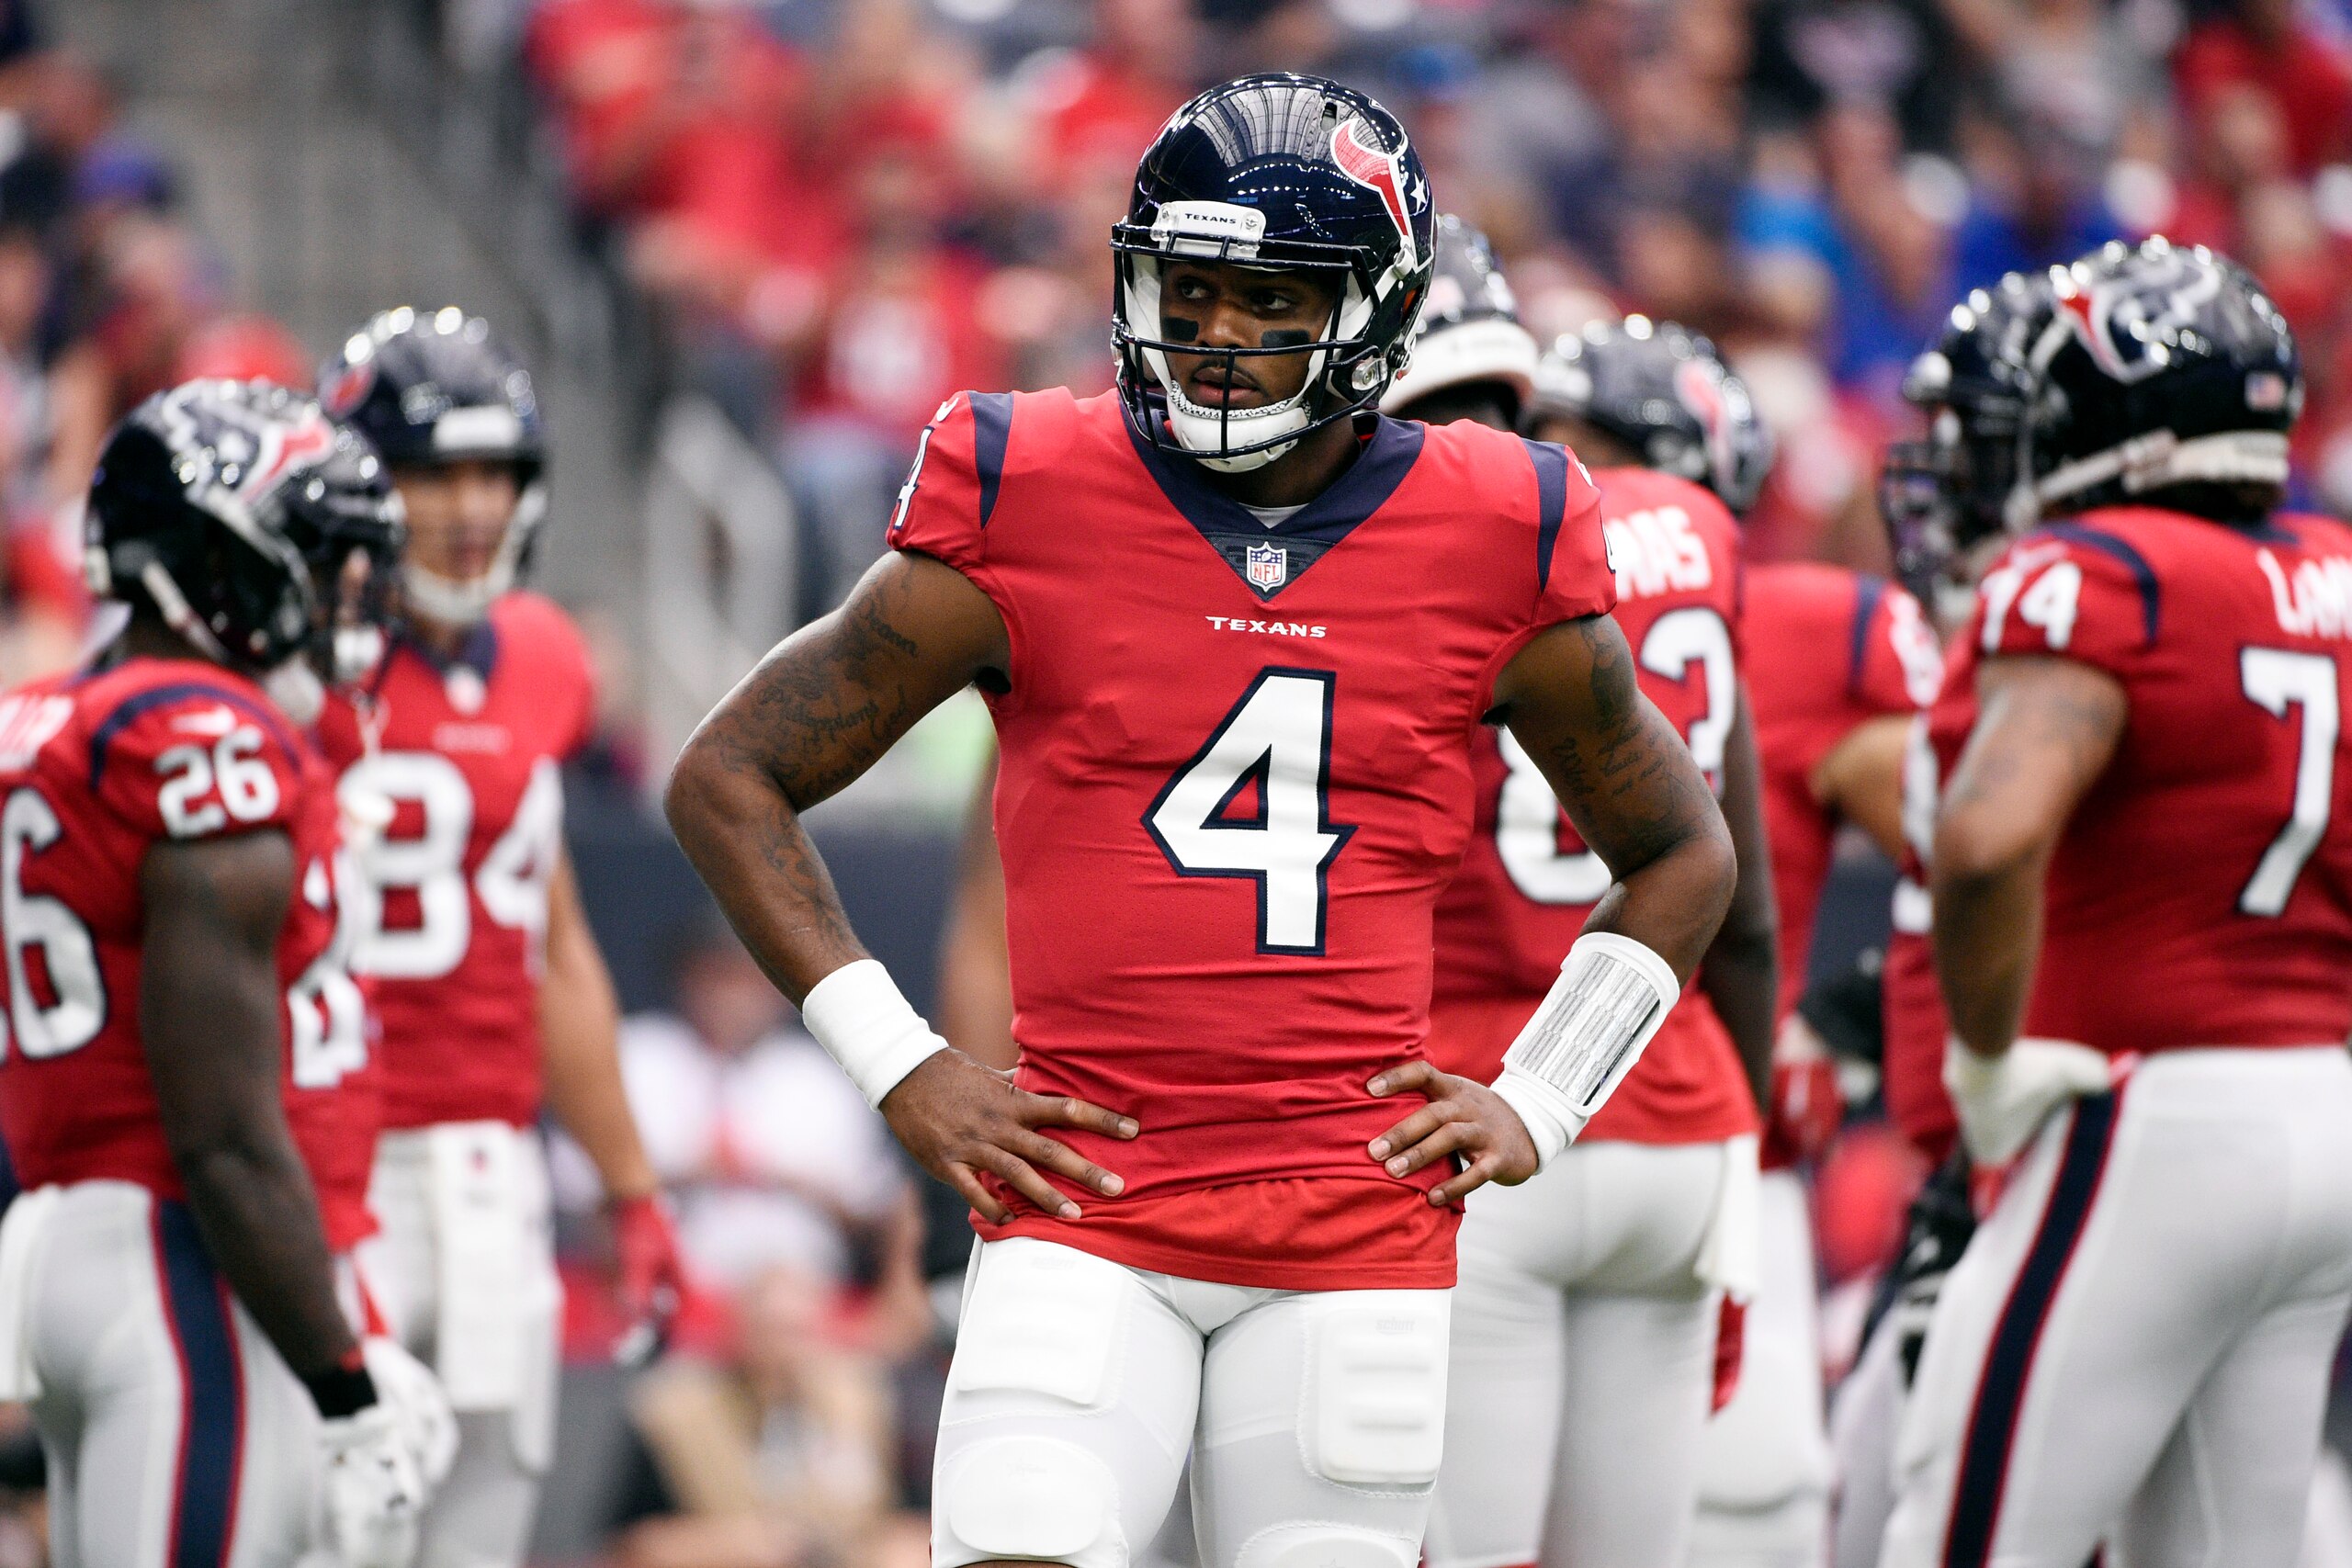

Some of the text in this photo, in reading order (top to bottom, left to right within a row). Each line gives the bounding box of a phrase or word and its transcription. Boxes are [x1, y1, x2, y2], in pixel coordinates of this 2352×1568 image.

[1184, 212, 1237, 224] TEXANS
[893, 425, 935, 530] 4
[1252, 563, 1280, 582] NFL
[1980, 560, 2082, 650] 74
[1204, 615, 1328, 638] TEXANS
[154, 728, 278, 838] 26
[1140, 665, 1359, 956] 4
[2238, 645, 2340, 917] 7
[336, 749, 566, 979] 84
[0, 785, 109, 1061] 6
